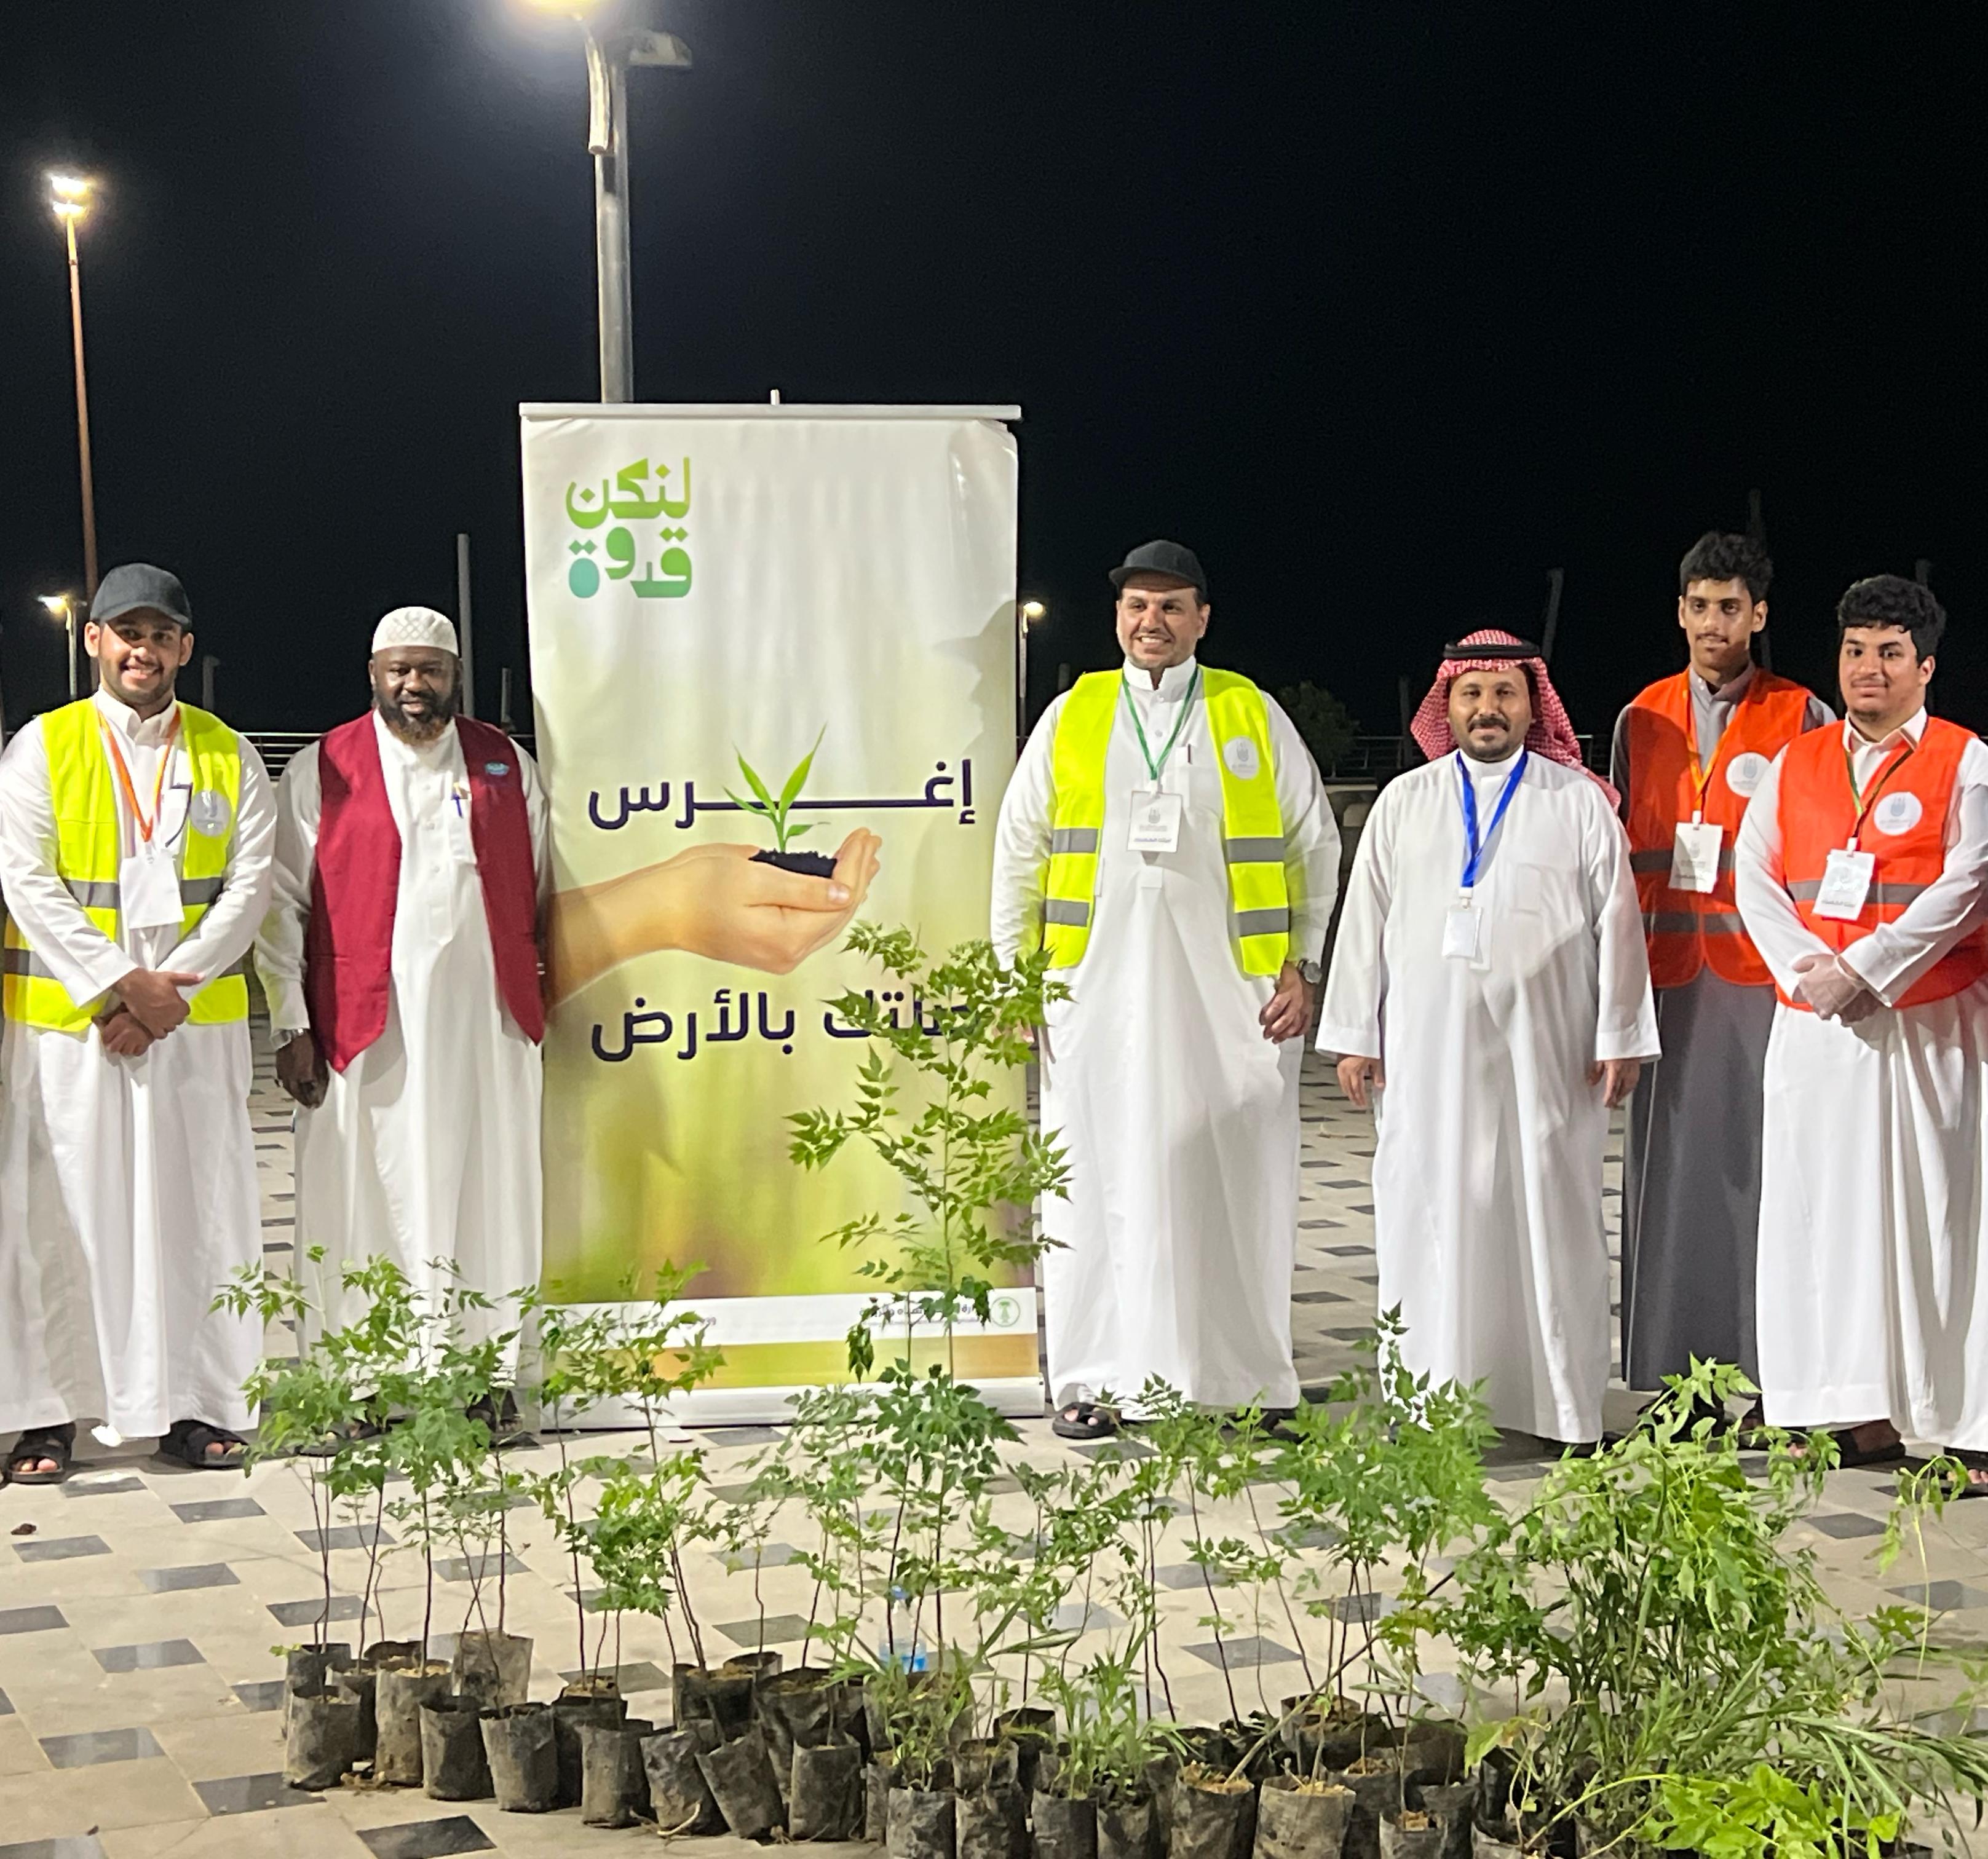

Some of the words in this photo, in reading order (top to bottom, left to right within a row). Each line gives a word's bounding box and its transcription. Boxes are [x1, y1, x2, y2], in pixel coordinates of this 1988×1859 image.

[566, 456, 691, 529] لنكن
[568, 527, 692, 599] قدوة
[591, 989, 794, 1062] بالأرض
